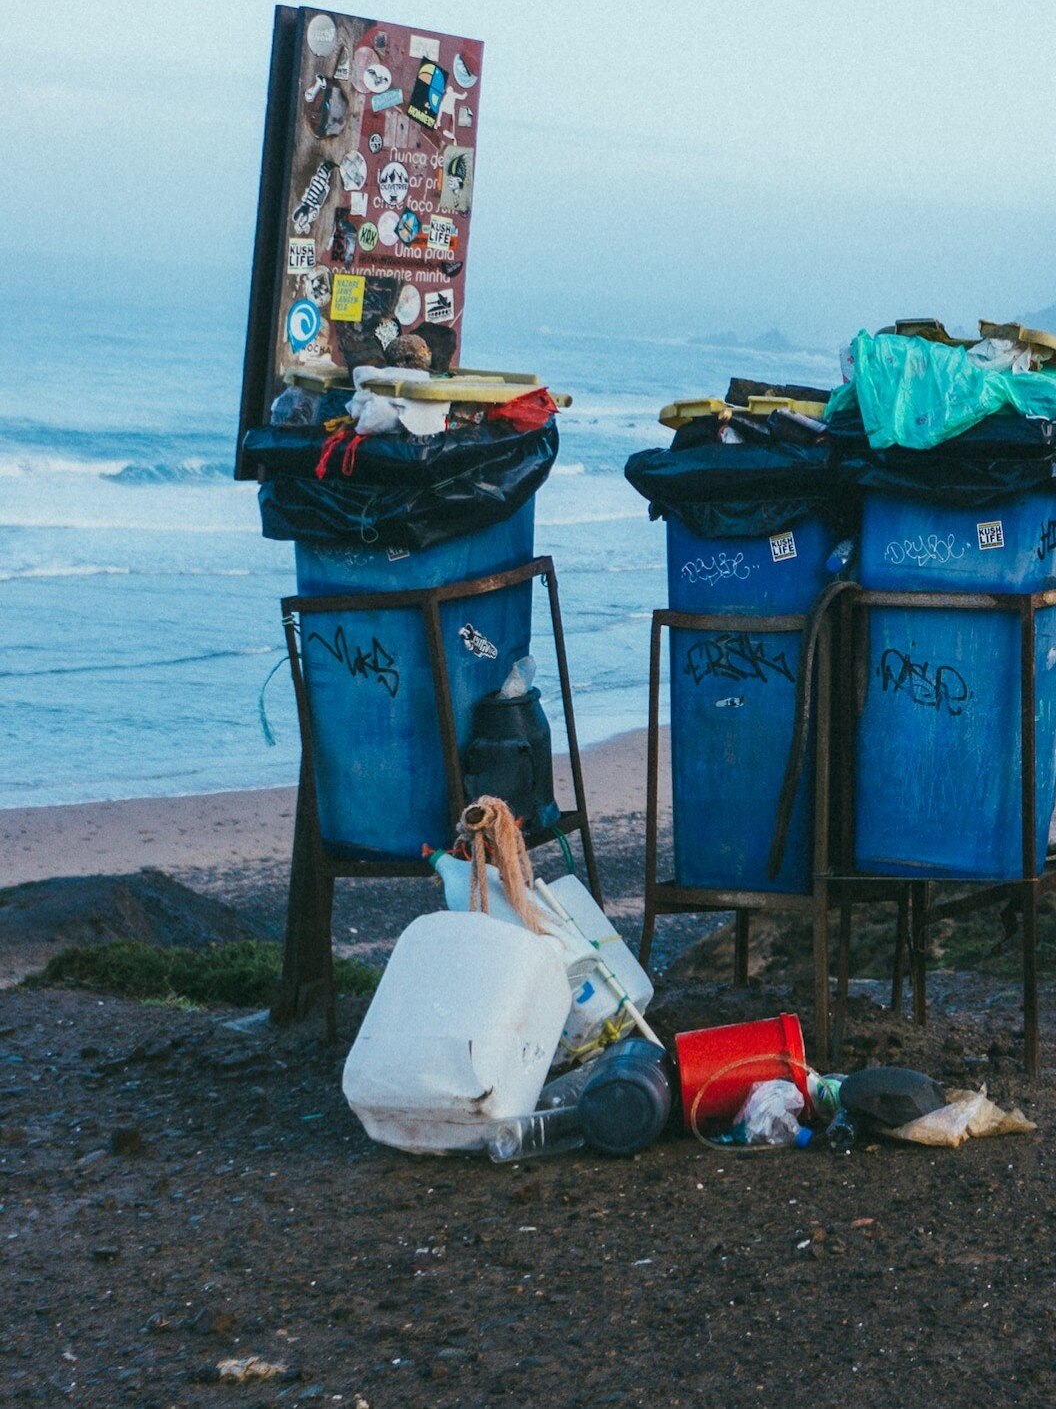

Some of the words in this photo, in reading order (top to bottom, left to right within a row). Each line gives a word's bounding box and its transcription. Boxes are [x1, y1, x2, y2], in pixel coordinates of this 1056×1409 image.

[389, 147, 427, 166] Nunca
[430, 151, 445, 169] de
[406, 195, 433, 215] faço
[430, 221, 452, 234] KUSH
[429, 231, 450, 245] LIFE
[289, 245, 314, 256] KUSH
[394, 243, 422, 259] Uma
[424, 247, 455, 263] praia
[289, 255, 315, 267] LIFE
[303, 343, 331, 354] OCHA
[977, 525, 1002, 536] KUSH
[771, 537, 793, 548] KUSH
[979, 533, 1003, 544] LIFE
[773, 544, 795, 556] LIFE
